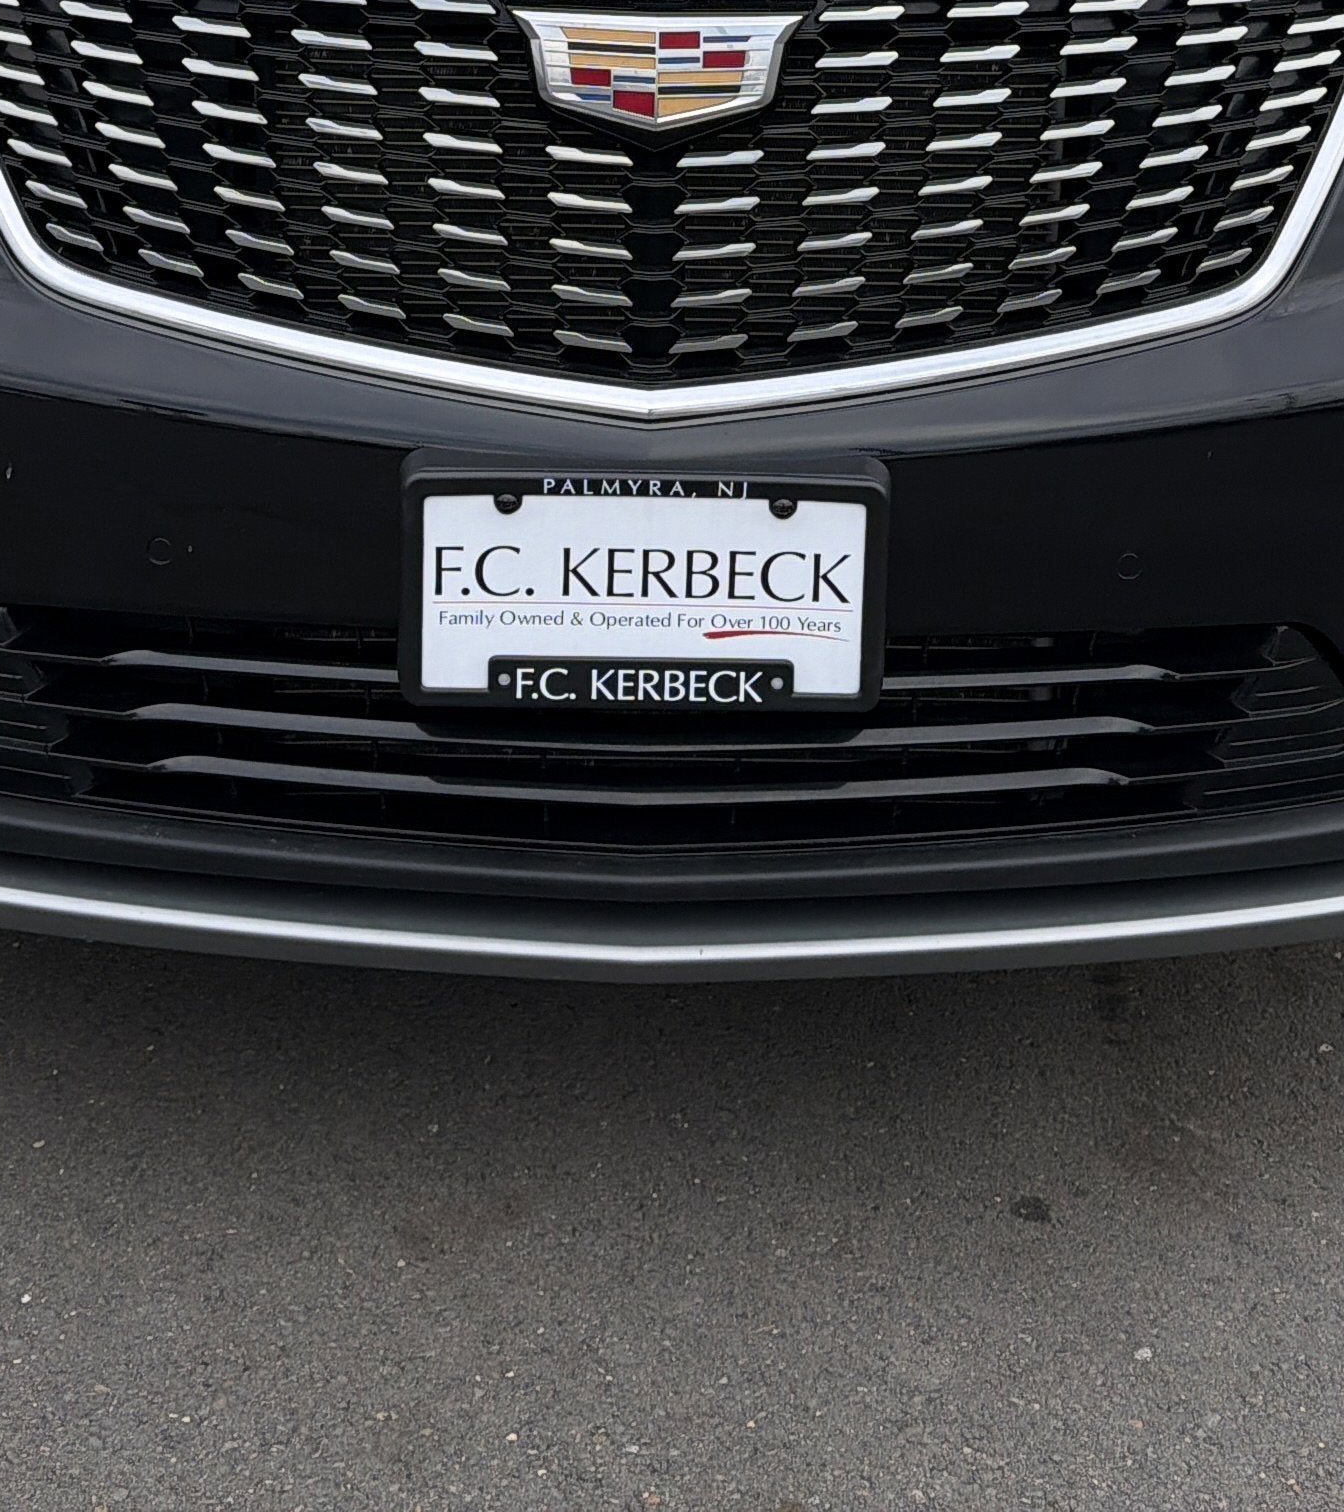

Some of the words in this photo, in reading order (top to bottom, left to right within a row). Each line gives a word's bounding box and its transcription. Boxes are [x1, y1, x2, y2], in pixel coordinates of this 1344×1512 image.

[542, 478, 697, 498] PALMYRA,
[717, 480, 748, 499] NJ
[433, 545, 535, 597] F.C.
[561, 547, 851, 604] KERBECK
[439, 610, 495, 628] Family
[499, 610, 564, 626] Owned
[570, 611, 584, 626] &
[589, 611, 671, 630] Operated
[677, 613, 705, 628] For
[711, 613, 754, 629] Over
[760, 615, 791, 630] 100
[798, 616, 842, 633] Years
[515, 667, 577, 700] F.C.
[590, 668, 764, 704] KERBECK
